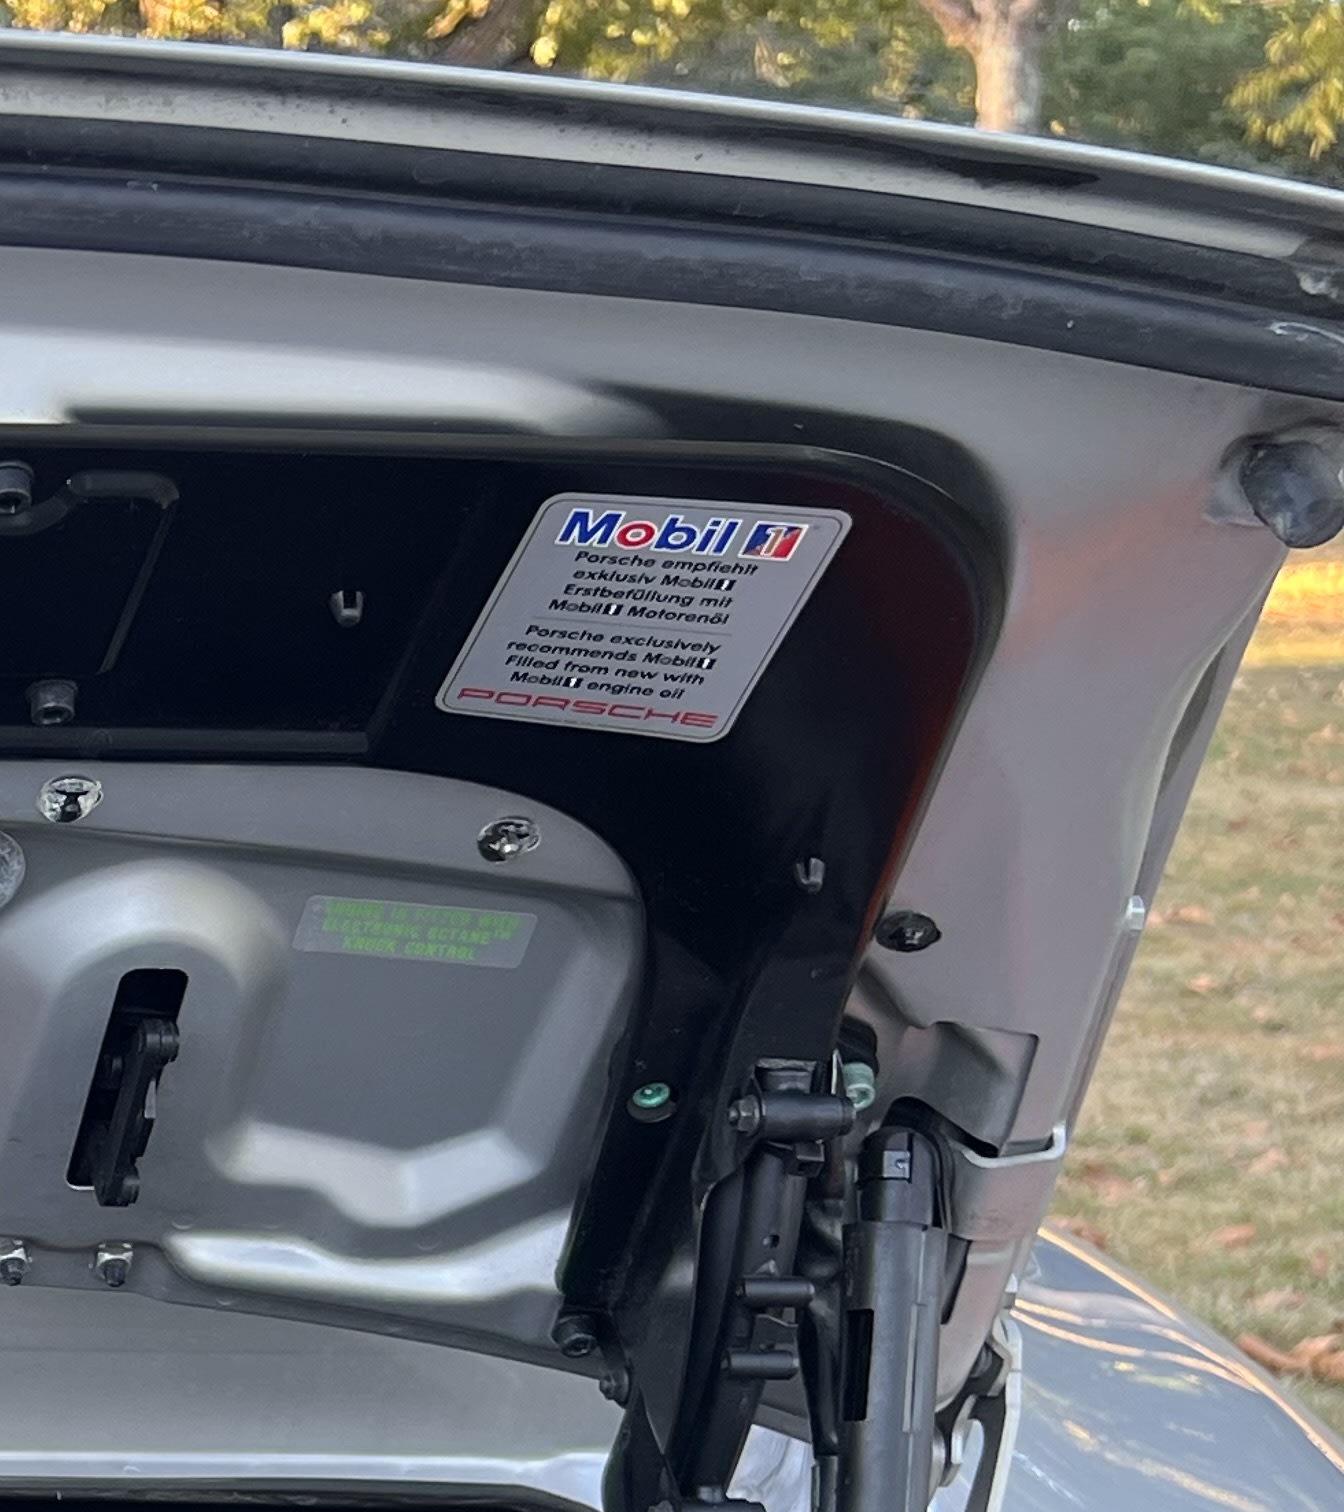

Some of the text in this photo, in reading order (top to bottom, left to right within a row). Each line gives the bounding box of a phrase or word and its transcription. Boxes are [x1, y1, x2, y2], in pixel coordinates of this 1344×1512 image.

[555, 508, 742, 556] Mobil
[574, 551, 759, 577] Porsche empfiehlt
[573, 569, 657, 586] exklusiv
[563, 584, 733, 609] Erstbefüllung mit
[627, 606, 730, 625] Motorenöl
[506, 641, 637, 663] recommends
[525, 624, 722, 655] Porsche exclusively
[505, 655, 705, 686] Filled from new with
[586, 679, 655, 698] engine
[659, 686, 685, 700] oil
[457, 687, 719, 728] PORSCHE
[405, 941, 476, 961] CONTROL
